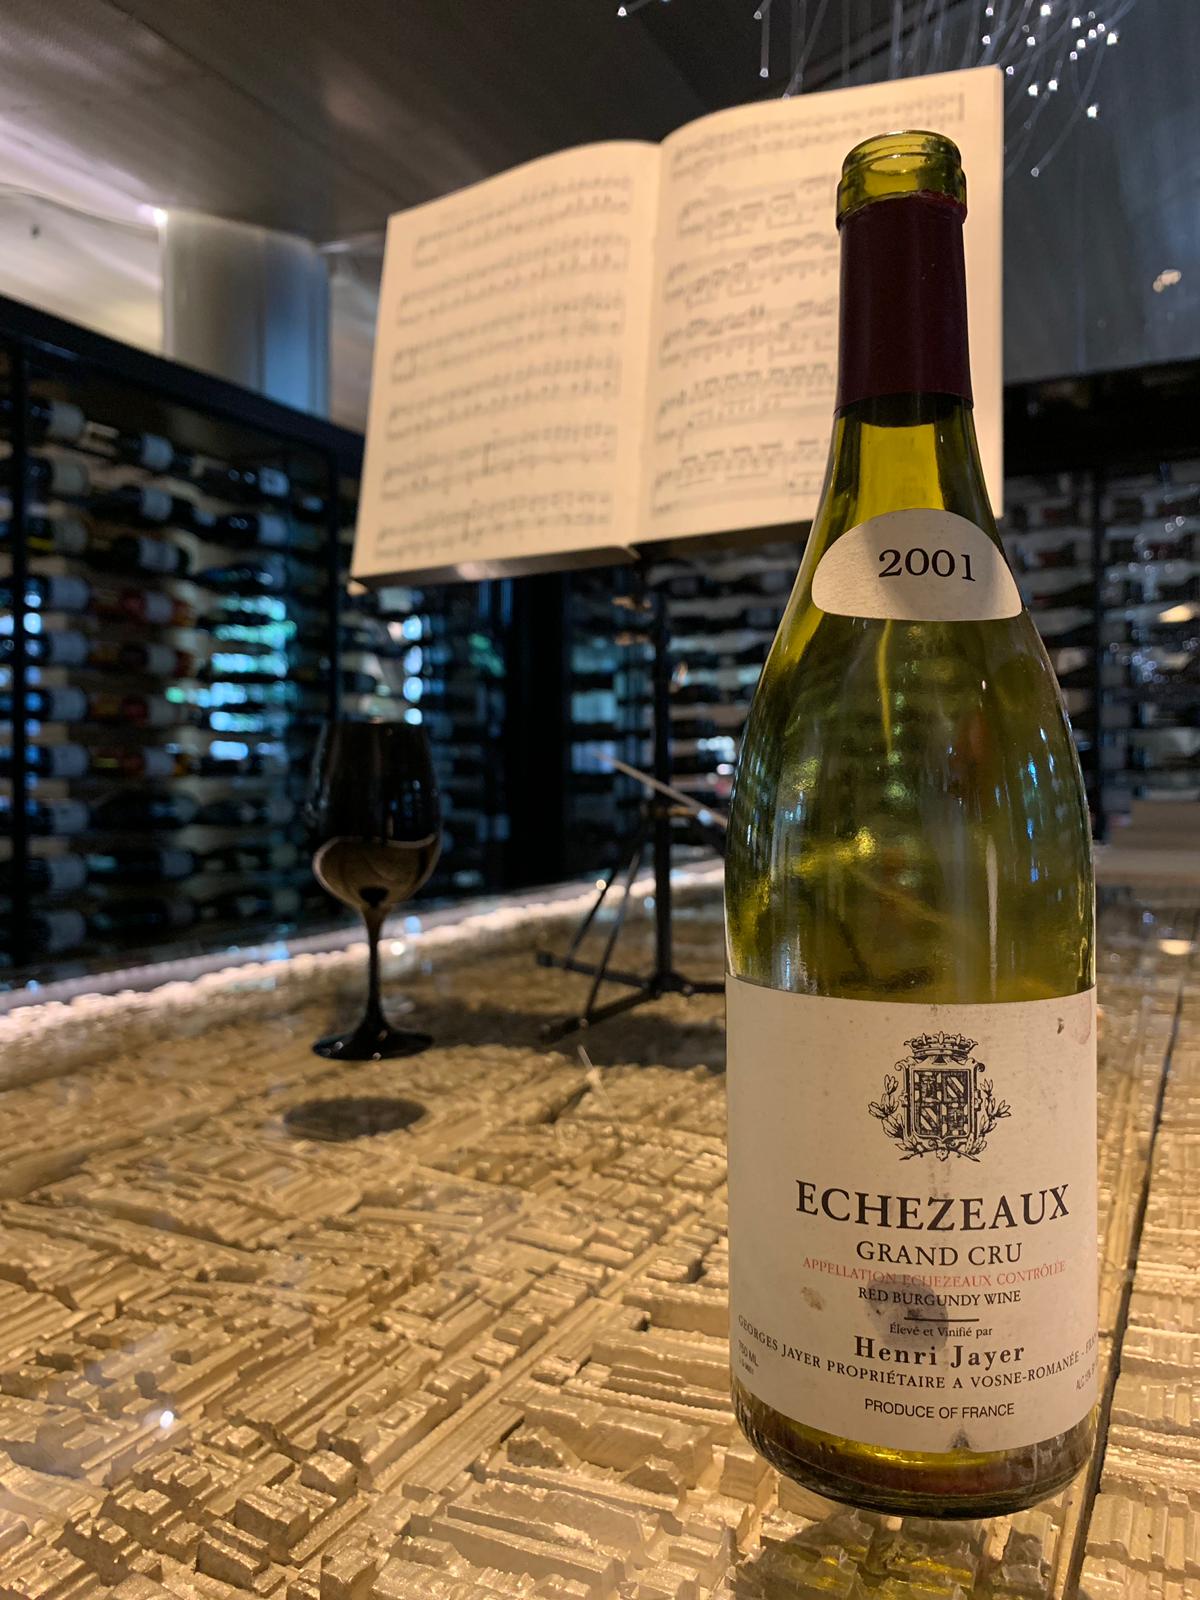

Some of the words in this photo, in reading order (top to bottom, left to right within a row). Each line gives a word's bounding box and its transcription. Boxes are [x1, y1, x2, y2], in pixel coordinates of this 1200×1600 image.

[878, 548, 976, 581] 2001
[796, 1179, 1069, 1231] ECHEZEAUX
[856, 1240, 958, 1267] GRAND
[968, 1242, 1023, 1265] CRU
[802, 1256, 897, 1285] APPELLATION
[858, 1287, 888, 1302] RED
[893, 1291, 980, 1307] BURGUNDY
[984, 1290, 1021, 1305] WINE
[889, 1322, 920, 1336] Élevé
[922, 1326, 933, 1336] et
[937, 1326, 972, 1337] Vinifié
[976, 1327, 993, 1339] par
[738, 1314, 778, 1351] GEORGES
[781, 1344, 821, 1369] JAYER
[827, 1360, 945, 1389] PROPRIÉTAIRE
[952, 1377, 963, 1389] A
[971, 1350, 1080, 1388] VOSNE-ROMANÉE
[853, 1335, 937, 1366] Henri
[950, 1344, 1025, 1372] Jayer
[864, 1398, 934, 1419] PRODUCE
[938, 1406, 959, 1419] OF
[962, 1402, 1015, 1419] FRANCE
